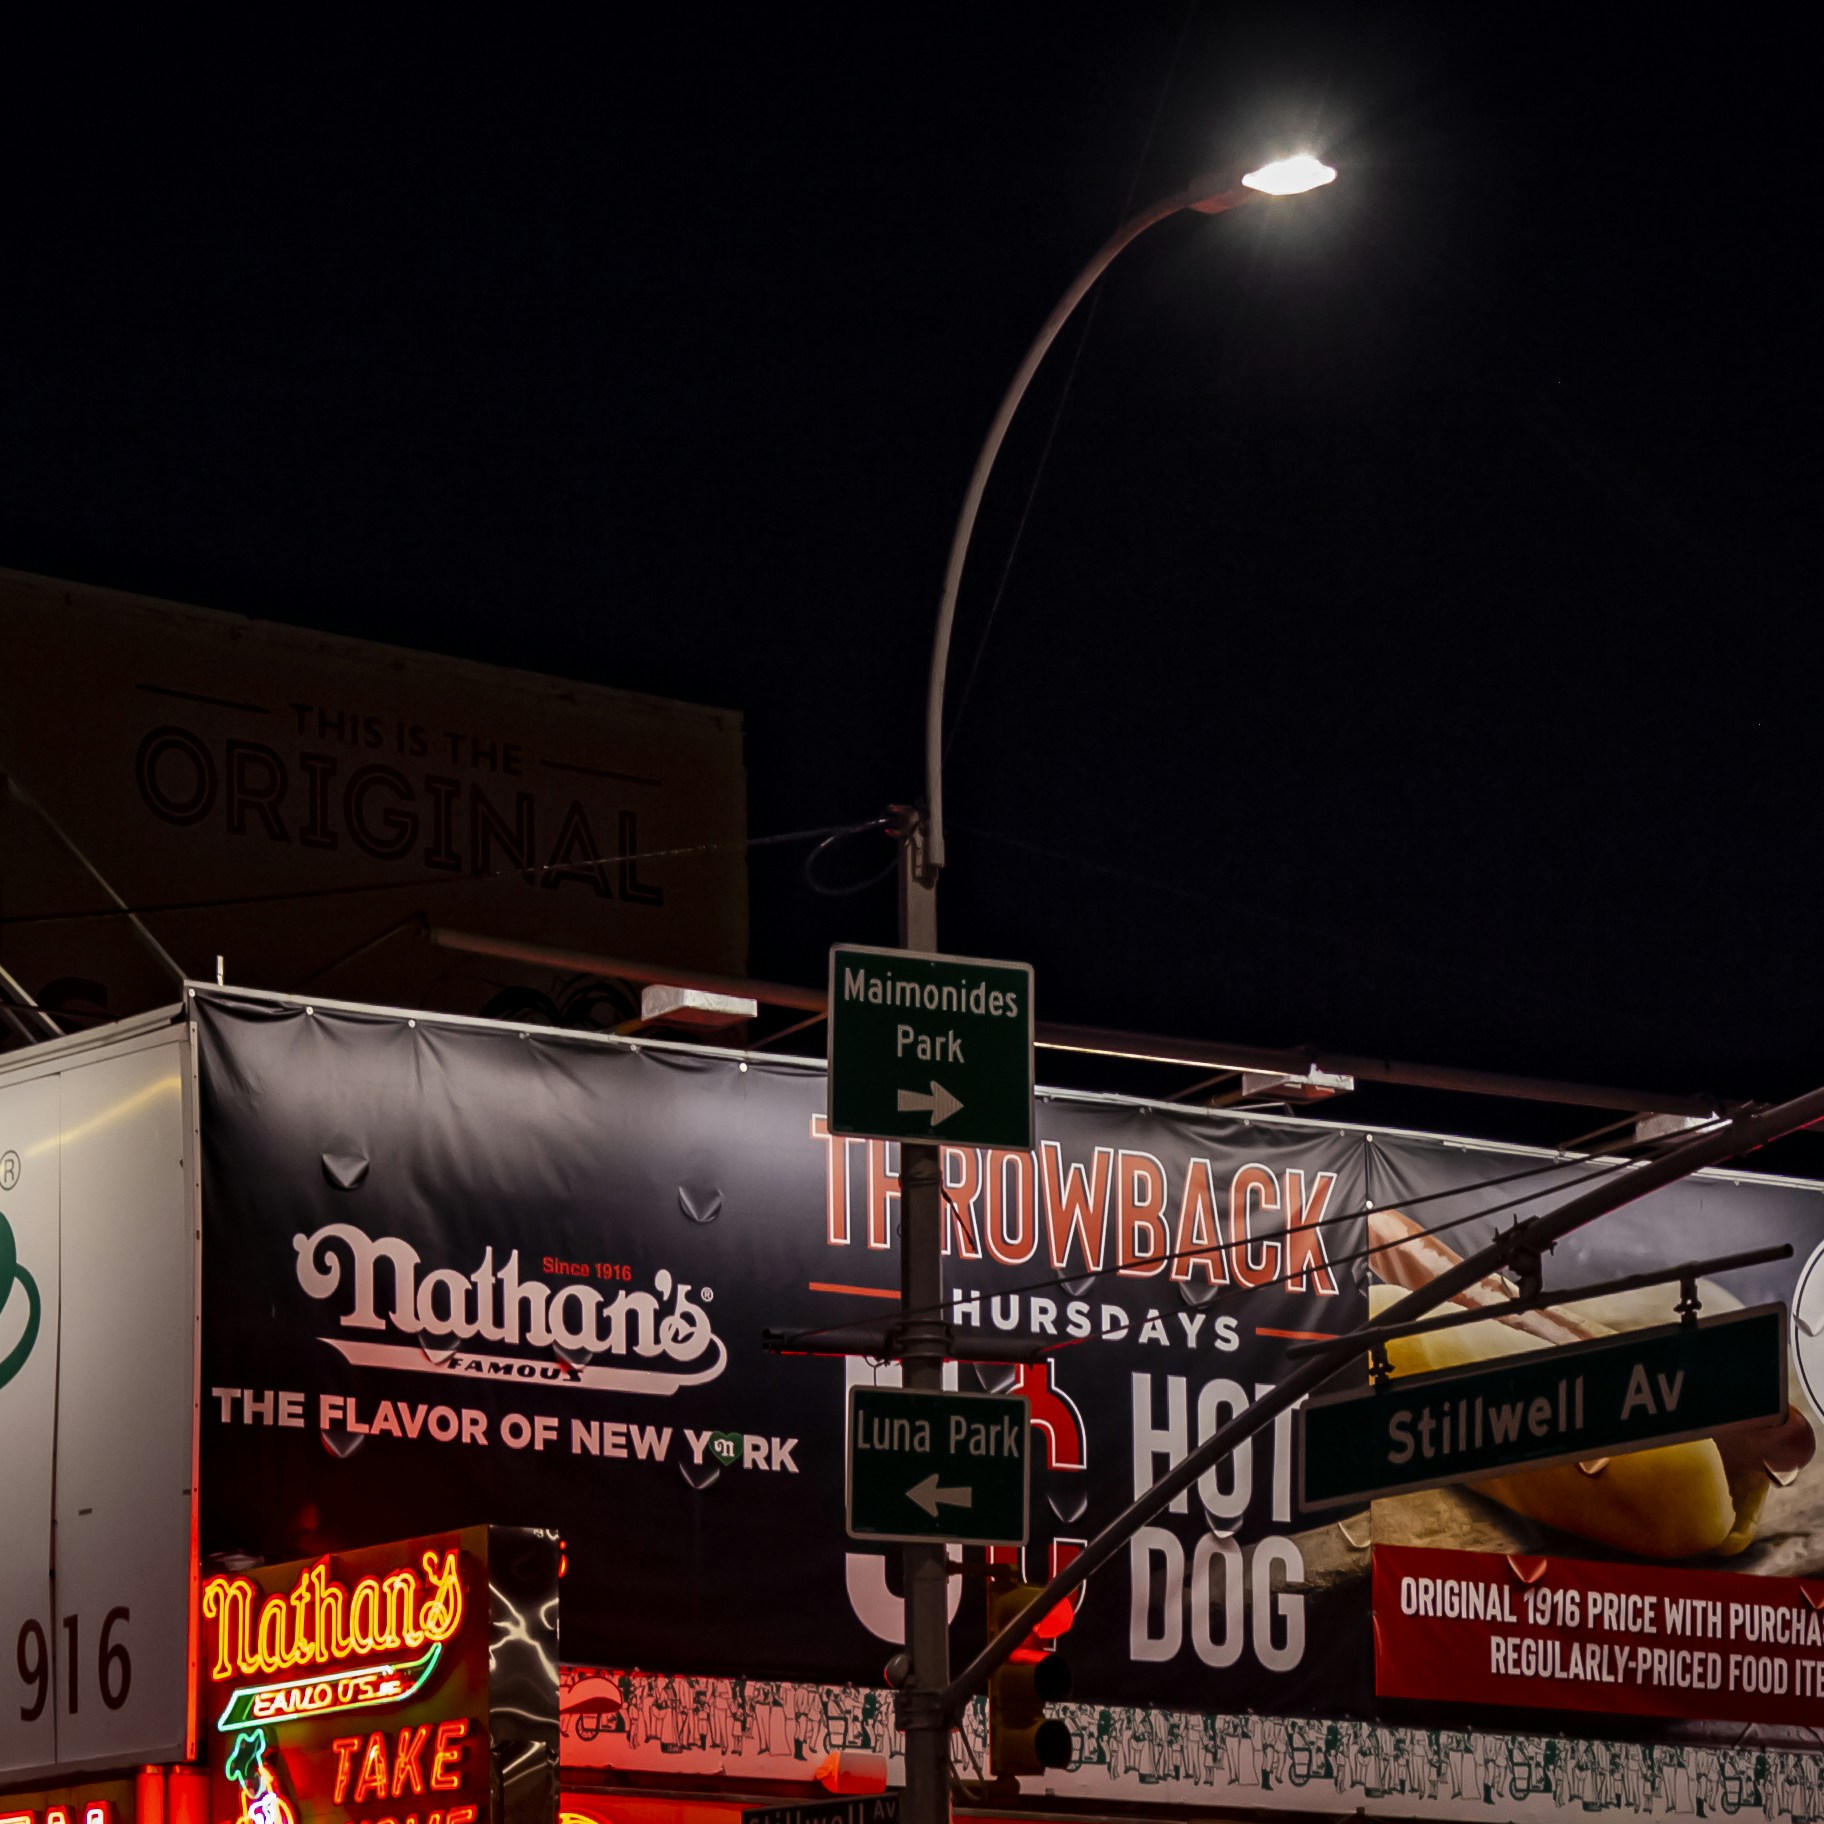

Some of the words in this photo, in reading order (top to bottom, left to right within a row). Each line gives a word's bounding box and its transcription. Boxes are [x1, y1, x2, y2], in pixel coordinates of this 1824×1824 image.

[288, 702, 384, 750] THIS
[397, 721, 428, 758] IS
[443, 730, 524, 776] THE
[134, 724, 664, 908] ORIGINAL
[843, 968, 1019, 1019] Maimonides
[896, 1025, 966, 1066] Park
[292, 1222, 727, 1362] Nathan's
[542, 1256, 590, 1278] Since
[594, 1262, 632, 1282] 1916
[952, 1286, 1240, 1352] HURSDAYS
[448, 1355, 584, 1384] FAMOUS
[211, 1386, 306, 1429] THE
[319, 1394, 489, 1446] FLAVOR
[501, 1412, 559, 1451] OF
[571, 1418, 673, 1463] NEW
[857, 1409, 932, 1454] Luna
[950, 1414, 1020, 1459] Park
[1131, 1371, 1310, 1524] HOT
[1387, 1375, 1586, 1467] Stillwell
[1620, 1362, 1686, 1422] Av
[205, 1549, 463, 1682] Nathan's
[1130, 1525, 1306, 1673] DOG
[1400, 1576, 1517, 1623] ORIGINAL
[1523, 1586, 1581, 1630] 1916
[1586, 1591, 1659, 1635] PRICE
[1664, 1596, 1724, 1640] WITH
[1489, 1635, 1723, 1695] REGULARLY-PRICED
[1728, 1654, 1787, 1695] FOOD
[332, 1717, 472, 1805] TAKE
[873, 1800, 897, 1823] AV
